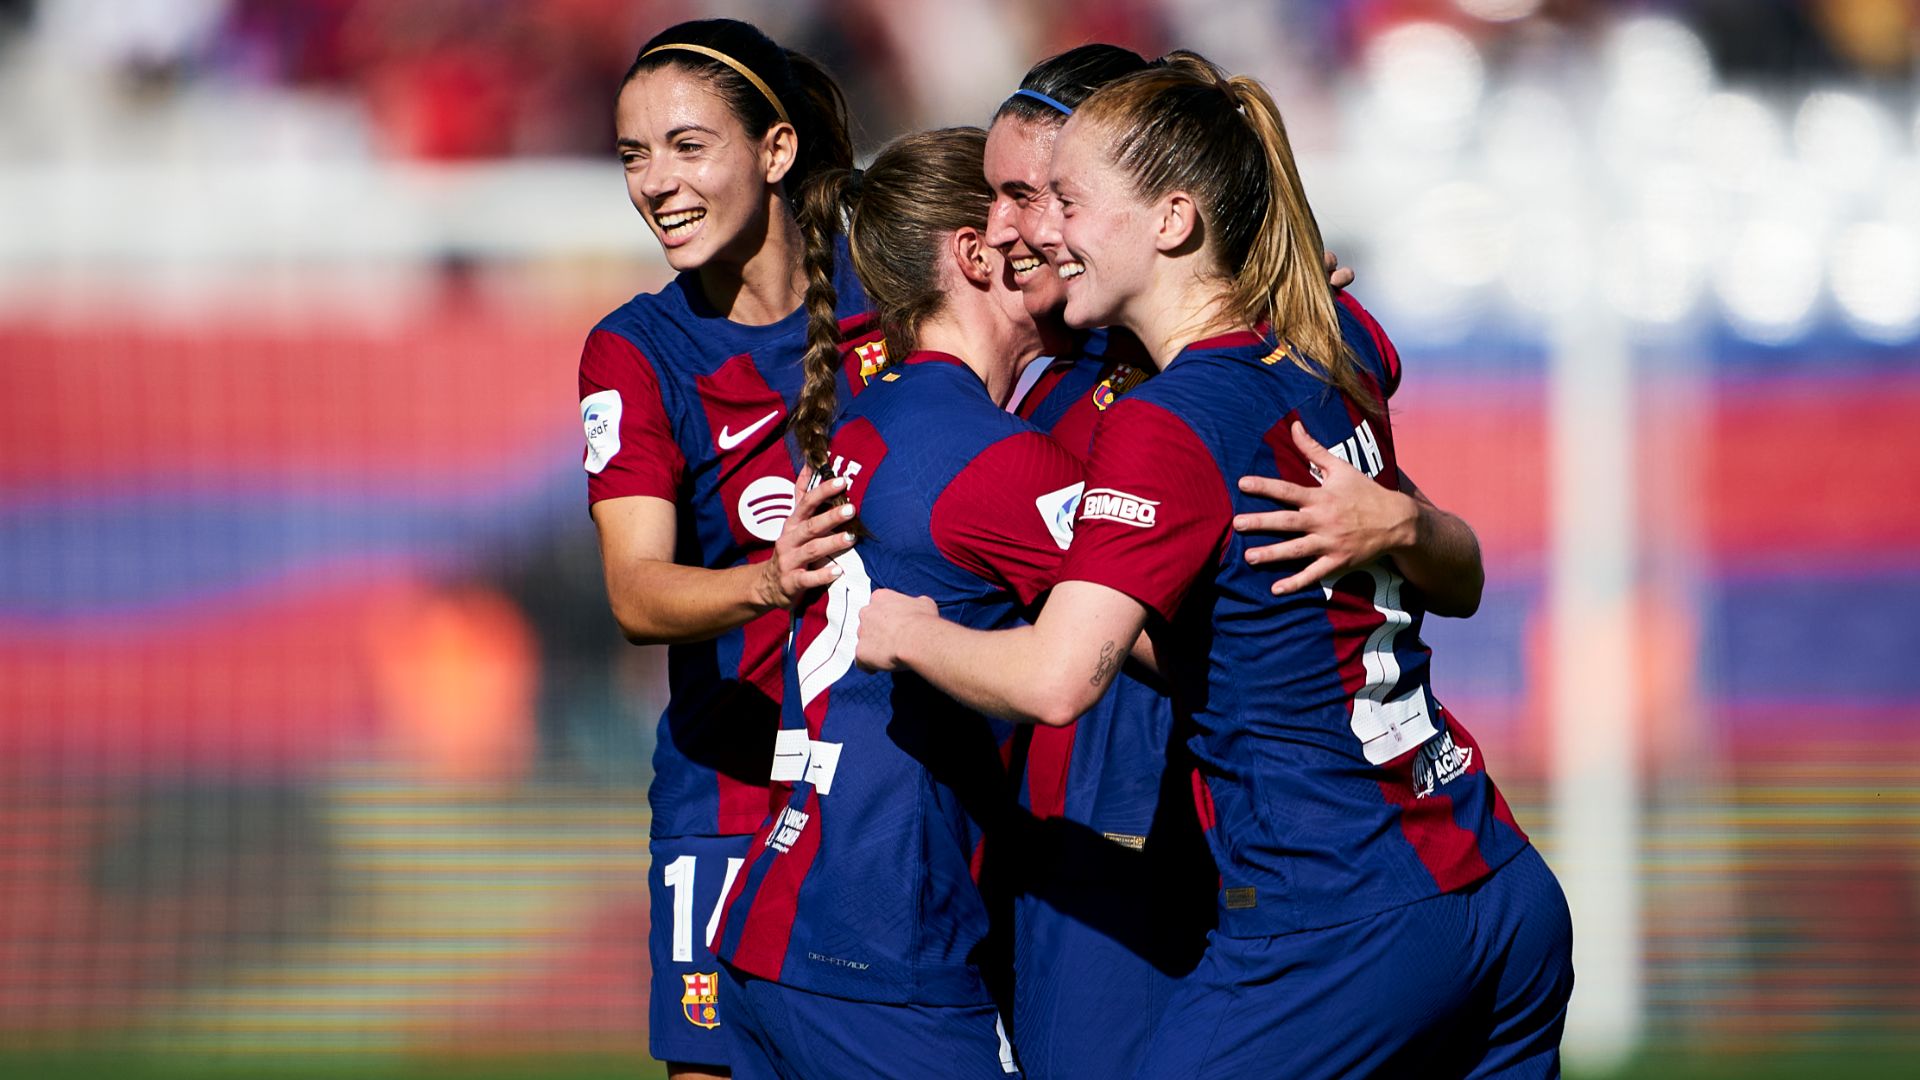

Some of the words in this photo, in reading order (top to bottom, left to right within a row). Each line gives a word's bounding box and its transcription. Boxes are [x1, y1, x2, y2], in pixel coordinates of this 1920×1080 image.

[587, 420, 608, 439] igaF
[1084, 494, 1156, 523] BIMBO
[1424, 731, 1455, 760] UNH
